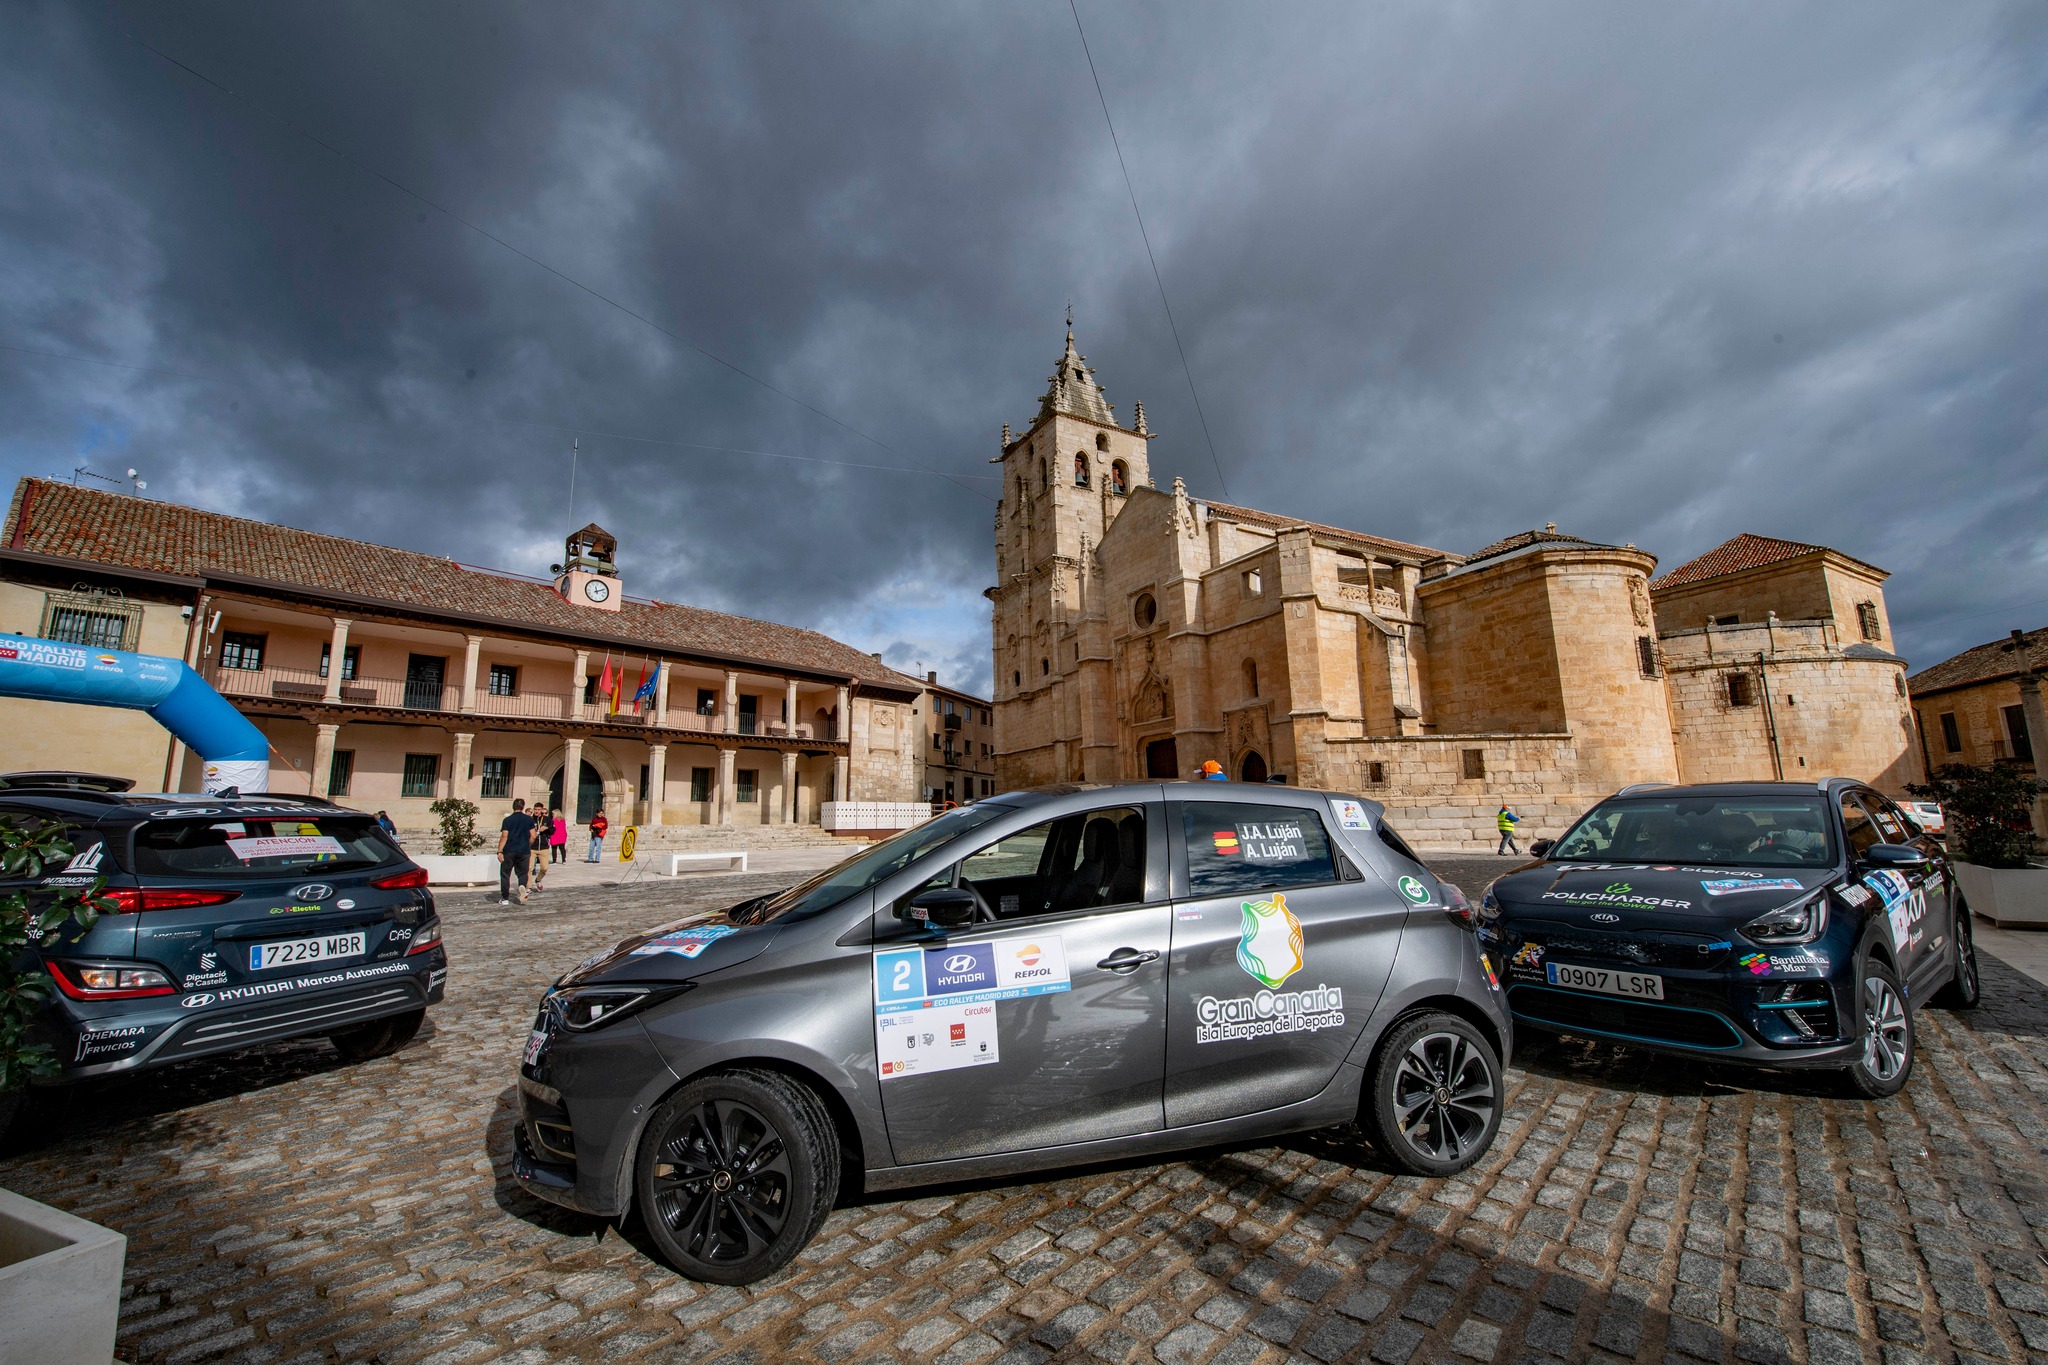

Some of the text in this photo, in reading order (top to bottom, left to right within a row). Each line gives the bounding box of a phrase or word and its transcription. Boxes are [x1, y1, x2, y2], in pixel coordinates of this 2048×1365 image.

[17, 650, 87, 668] MADRID
[32, 643, 87, 658] RALLYE
[93, 664, 124, 673] REPSOL
[1241, 824, 1302, 841] J.A. Luján
[256, 837, 316, 846] ATENCIÓN
[1247, 842, 1298, 860] A. Luján
[1541, 891, 1691, 910] POLICHARGER
[1615, 902, 1656, 910] POWER
[389, 929, 412, 941] CAS
[267, 941, 320, 965] 7229
[327, 936, 361, 956] MBR
[185, 970, 227, 982] Diputació
[893, 960, 911, 992] 2
[1015, 967, 1052, 979] REPSOL
[1782, 965, 1806, 973] Mar
[183, 977, 228, 989] de Castelló
[219, 962, 410, 1001] HYUNDAI Marcos Automoción
[938, 972, 985, 986] HYUNDAI
[1561, 967, 1609, 989] 0907
[1616, 974, 1657, 996] LSR
[934, 989, 1020, 1008] ECO RALLYE MADRID 2023
[1198, 984, 1341, 1024] Gran Canaria
[1198, 1013, 1343, 1042] Isla Europea del Deporte
